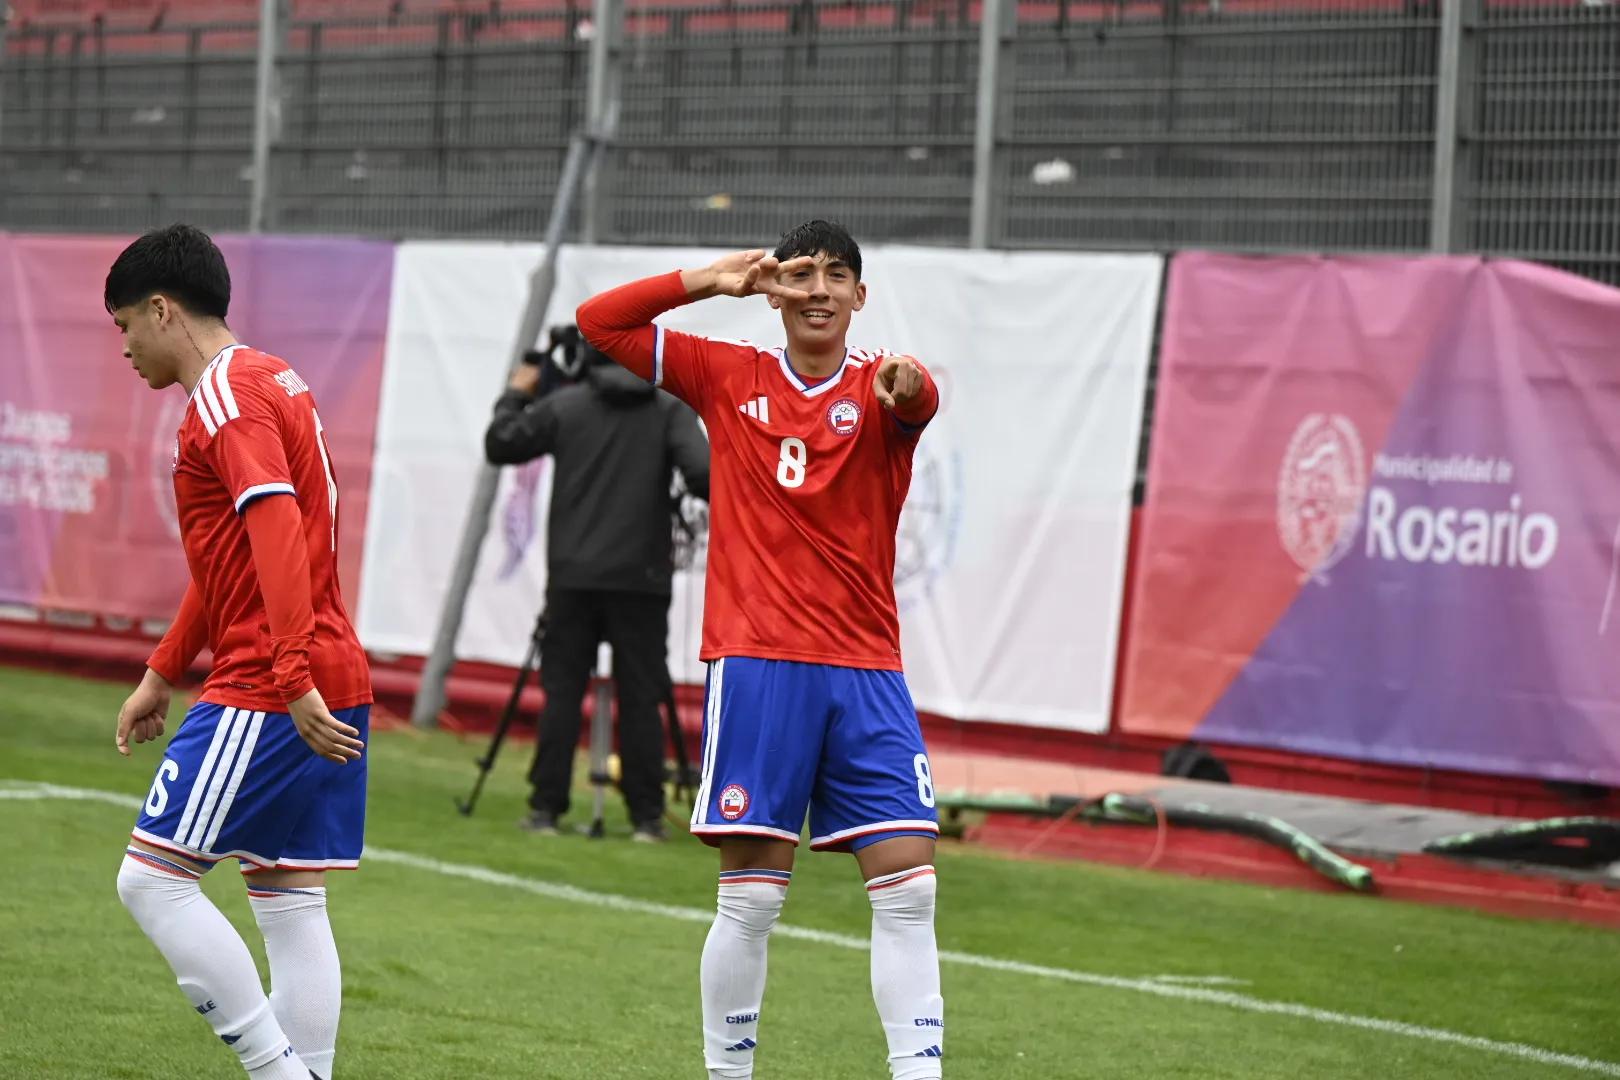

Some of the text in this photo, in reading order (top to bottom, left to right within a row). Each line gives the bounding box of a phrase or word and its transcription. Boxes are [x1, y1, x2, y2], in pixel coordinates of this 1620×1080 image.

[776, 437, 807, 488] 8
[1365, 486, 1558, 569] Rosario
[145, 759, 179, 818] 6
[913, 753, 936, 809] 8
[725, 1012, 758, 1024] CHILE
[914, 1018, 944, 1028] CHILE
